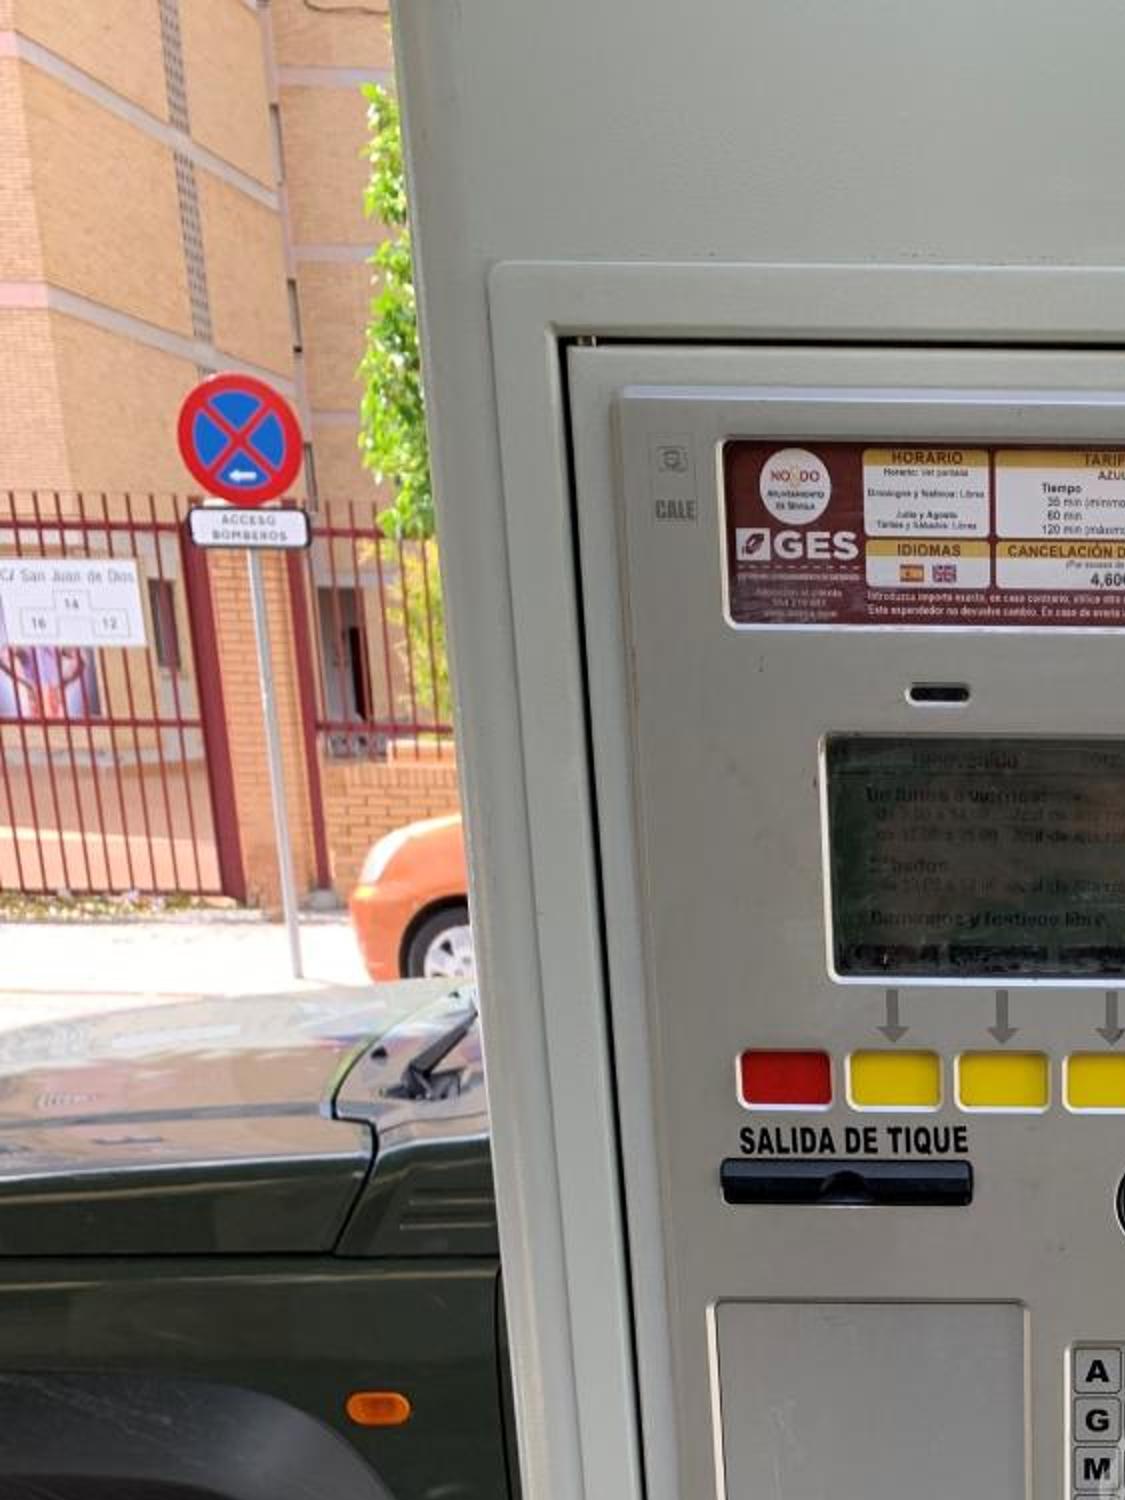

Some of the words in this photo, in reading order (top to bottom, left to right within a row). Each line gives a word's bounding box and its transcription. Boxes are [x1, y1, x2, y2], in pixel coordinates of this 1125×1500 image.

[891, 451, 963, 465] HORARIO
[1041, 483, 1082, 495] Tiempo
[1064, 497, 1082, 507] min
[221, 513, 277, 526] ACCESO
[1047, 510, 1061, 521] 60
[1064, 510, 1082, 521] min
[211, 530, 288, 541] BOMBEROS
[1042, 524, 1061, 535] 120
[1064, 524, 1082, 535] min
[773, 530, 859, 560] GES
[897, 544, 961, 557] IDIOMAS
[1007, 543, 1114, 558] CANCELACIÓN
[19, 570, 46, 582] San
[51, 570, 82, 583] Juan
[87, 570, 103, 583] de
[107, 570, 135, 583] Dios
[64, 598, 79, 609] 14
[31, 617, 46, 630] 16
[102, 618, 118, 630] 12
[739, 1127, 836, 1155] SALIDA
[845, 1126, 880, 1155] DE
[885, 1125, 968, 1155] TIQUE
[1085, 1359, 1110, 1383] A
[1085, 1408, 1110, 1433] G
[1083, 1457, 1111, 1481] M
